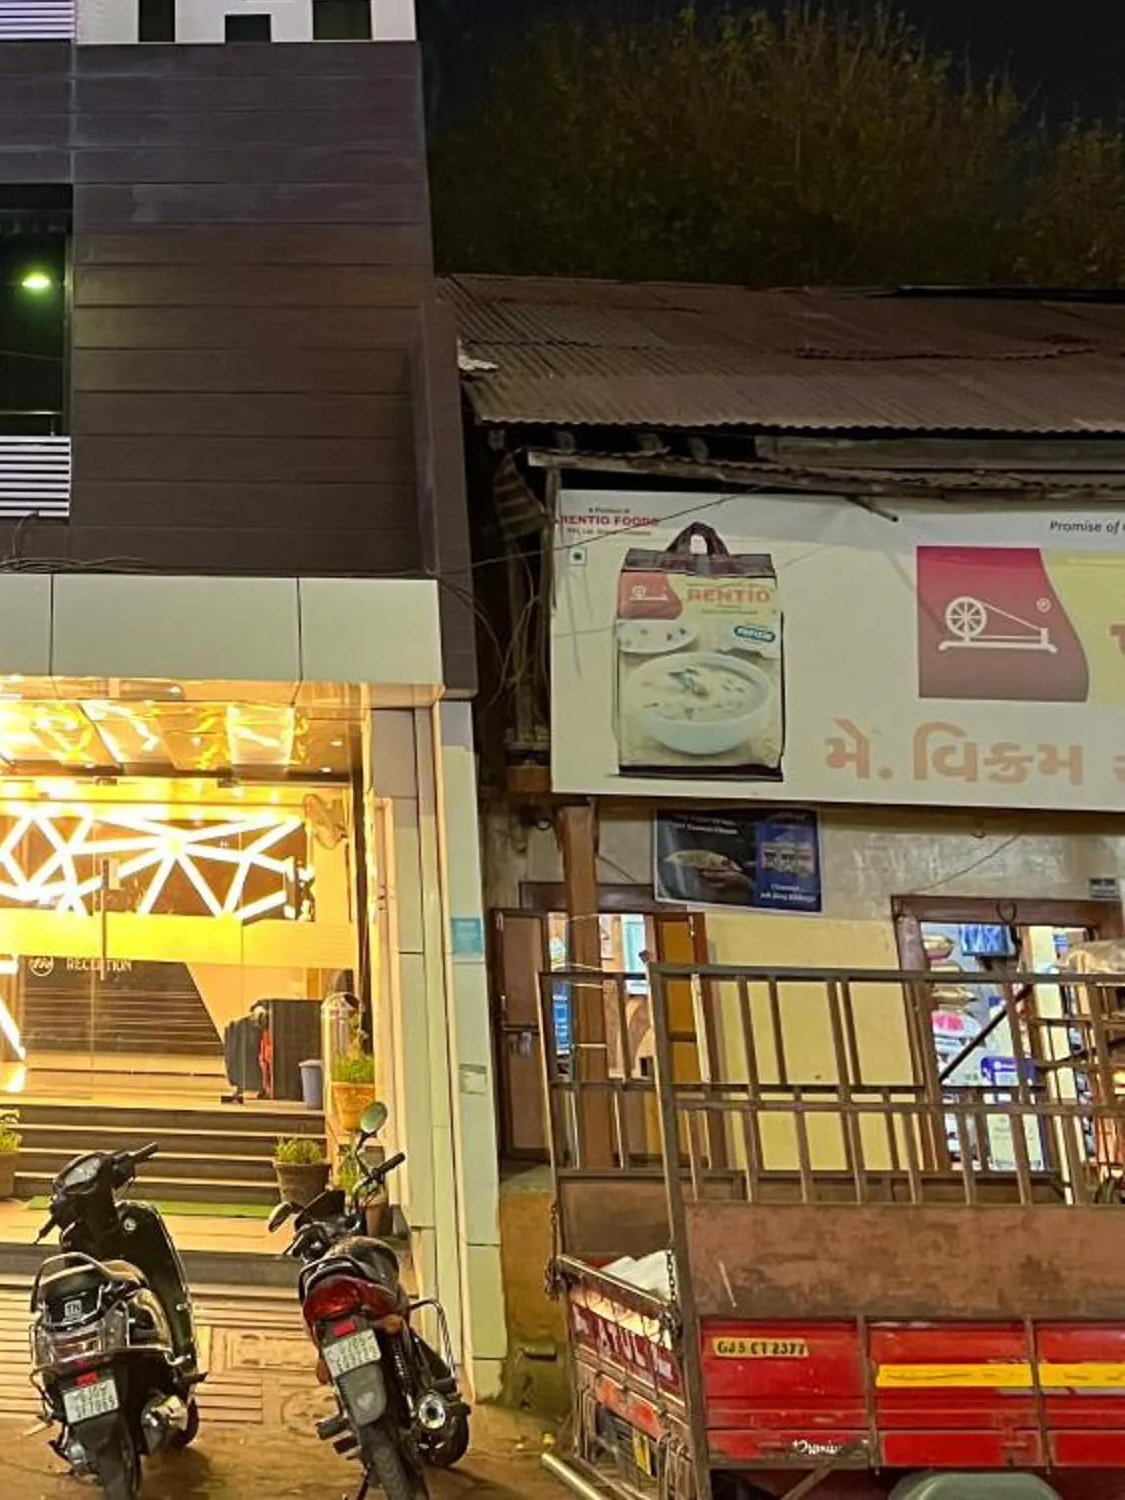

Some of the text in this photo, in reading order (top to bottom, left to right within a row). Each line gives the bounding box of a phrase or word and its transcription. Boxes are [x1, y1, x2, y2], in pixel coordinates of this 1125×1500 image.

[1049, 518, 1121, 536] Promise of
[686, 587, 771, 604] RENTIO
